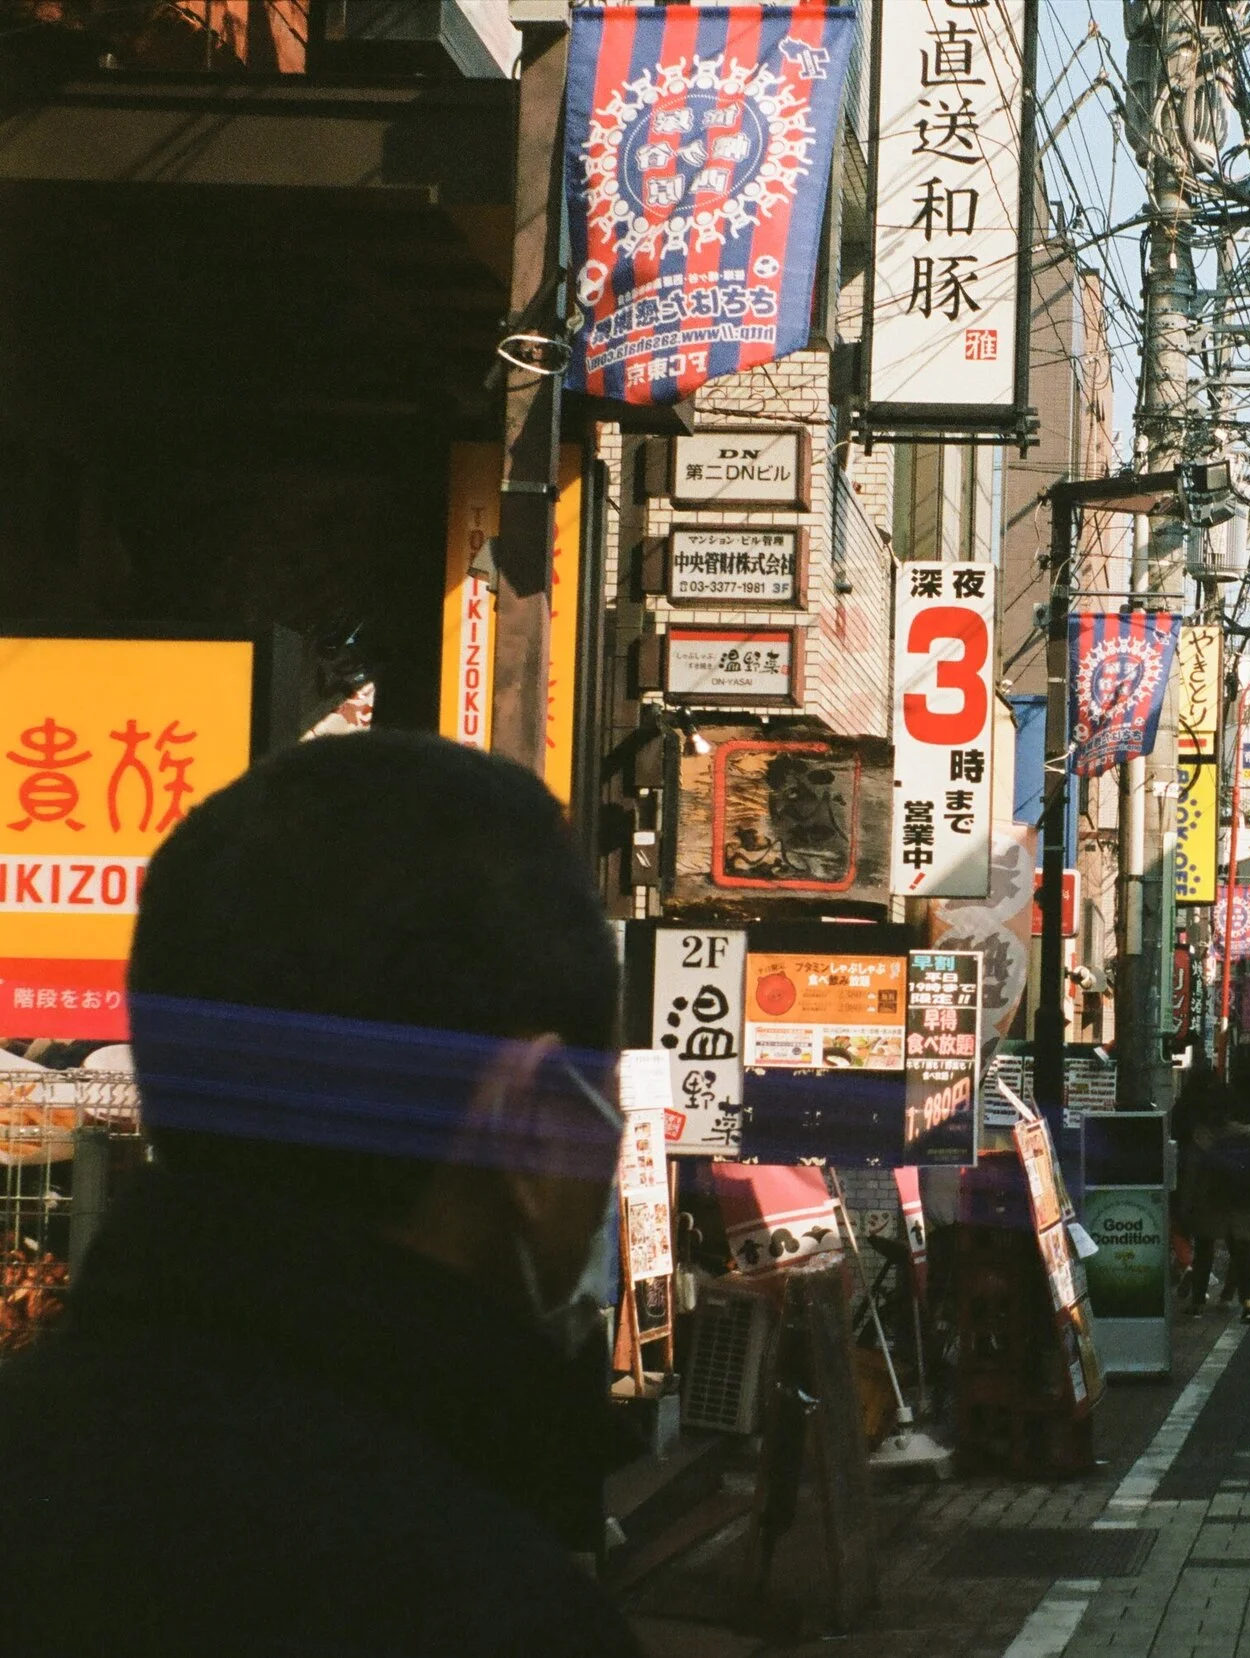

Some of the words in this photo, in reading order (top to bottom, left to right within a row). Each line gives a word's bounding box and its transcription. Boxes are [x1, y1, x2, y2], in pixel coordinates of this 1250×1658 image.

[905, 0, 990, 322] 直送和豚
[719, 449, 761, 459] DN
[686, 464, 790, 482] 第二DNビル
[688, 535, 784, 546] マンション・ビル管理
[674, 552, 794, 576] 中央管財株式会社
[910, 568, 986, 599] 深夜
[463, 507, 486, 736] TOIKIZOKU
[718, 649, 780, 675] 温野菜
[903, 606, 989, 746] 3
[1188, 629, 1214, 729] やきとり
[6, 718, 198, 834] 貴族
[943, 749, 985, 835] 時まで
[682, 935, 729, 968] 2F
[912, 956, 955, 971] 早割
[924, 972, 958, 982] 平日
[13, 987, 122, 1010] 階段をおり
[923, 1009, 958, 1031] 早得
[907, 1034, 974, 1056] 食べ放題
[661, 984, 743, 1145] 温野菜
[1103, 1218, 1144, 1232] Good
[1091, 1231, 1160, 1245] Condition
